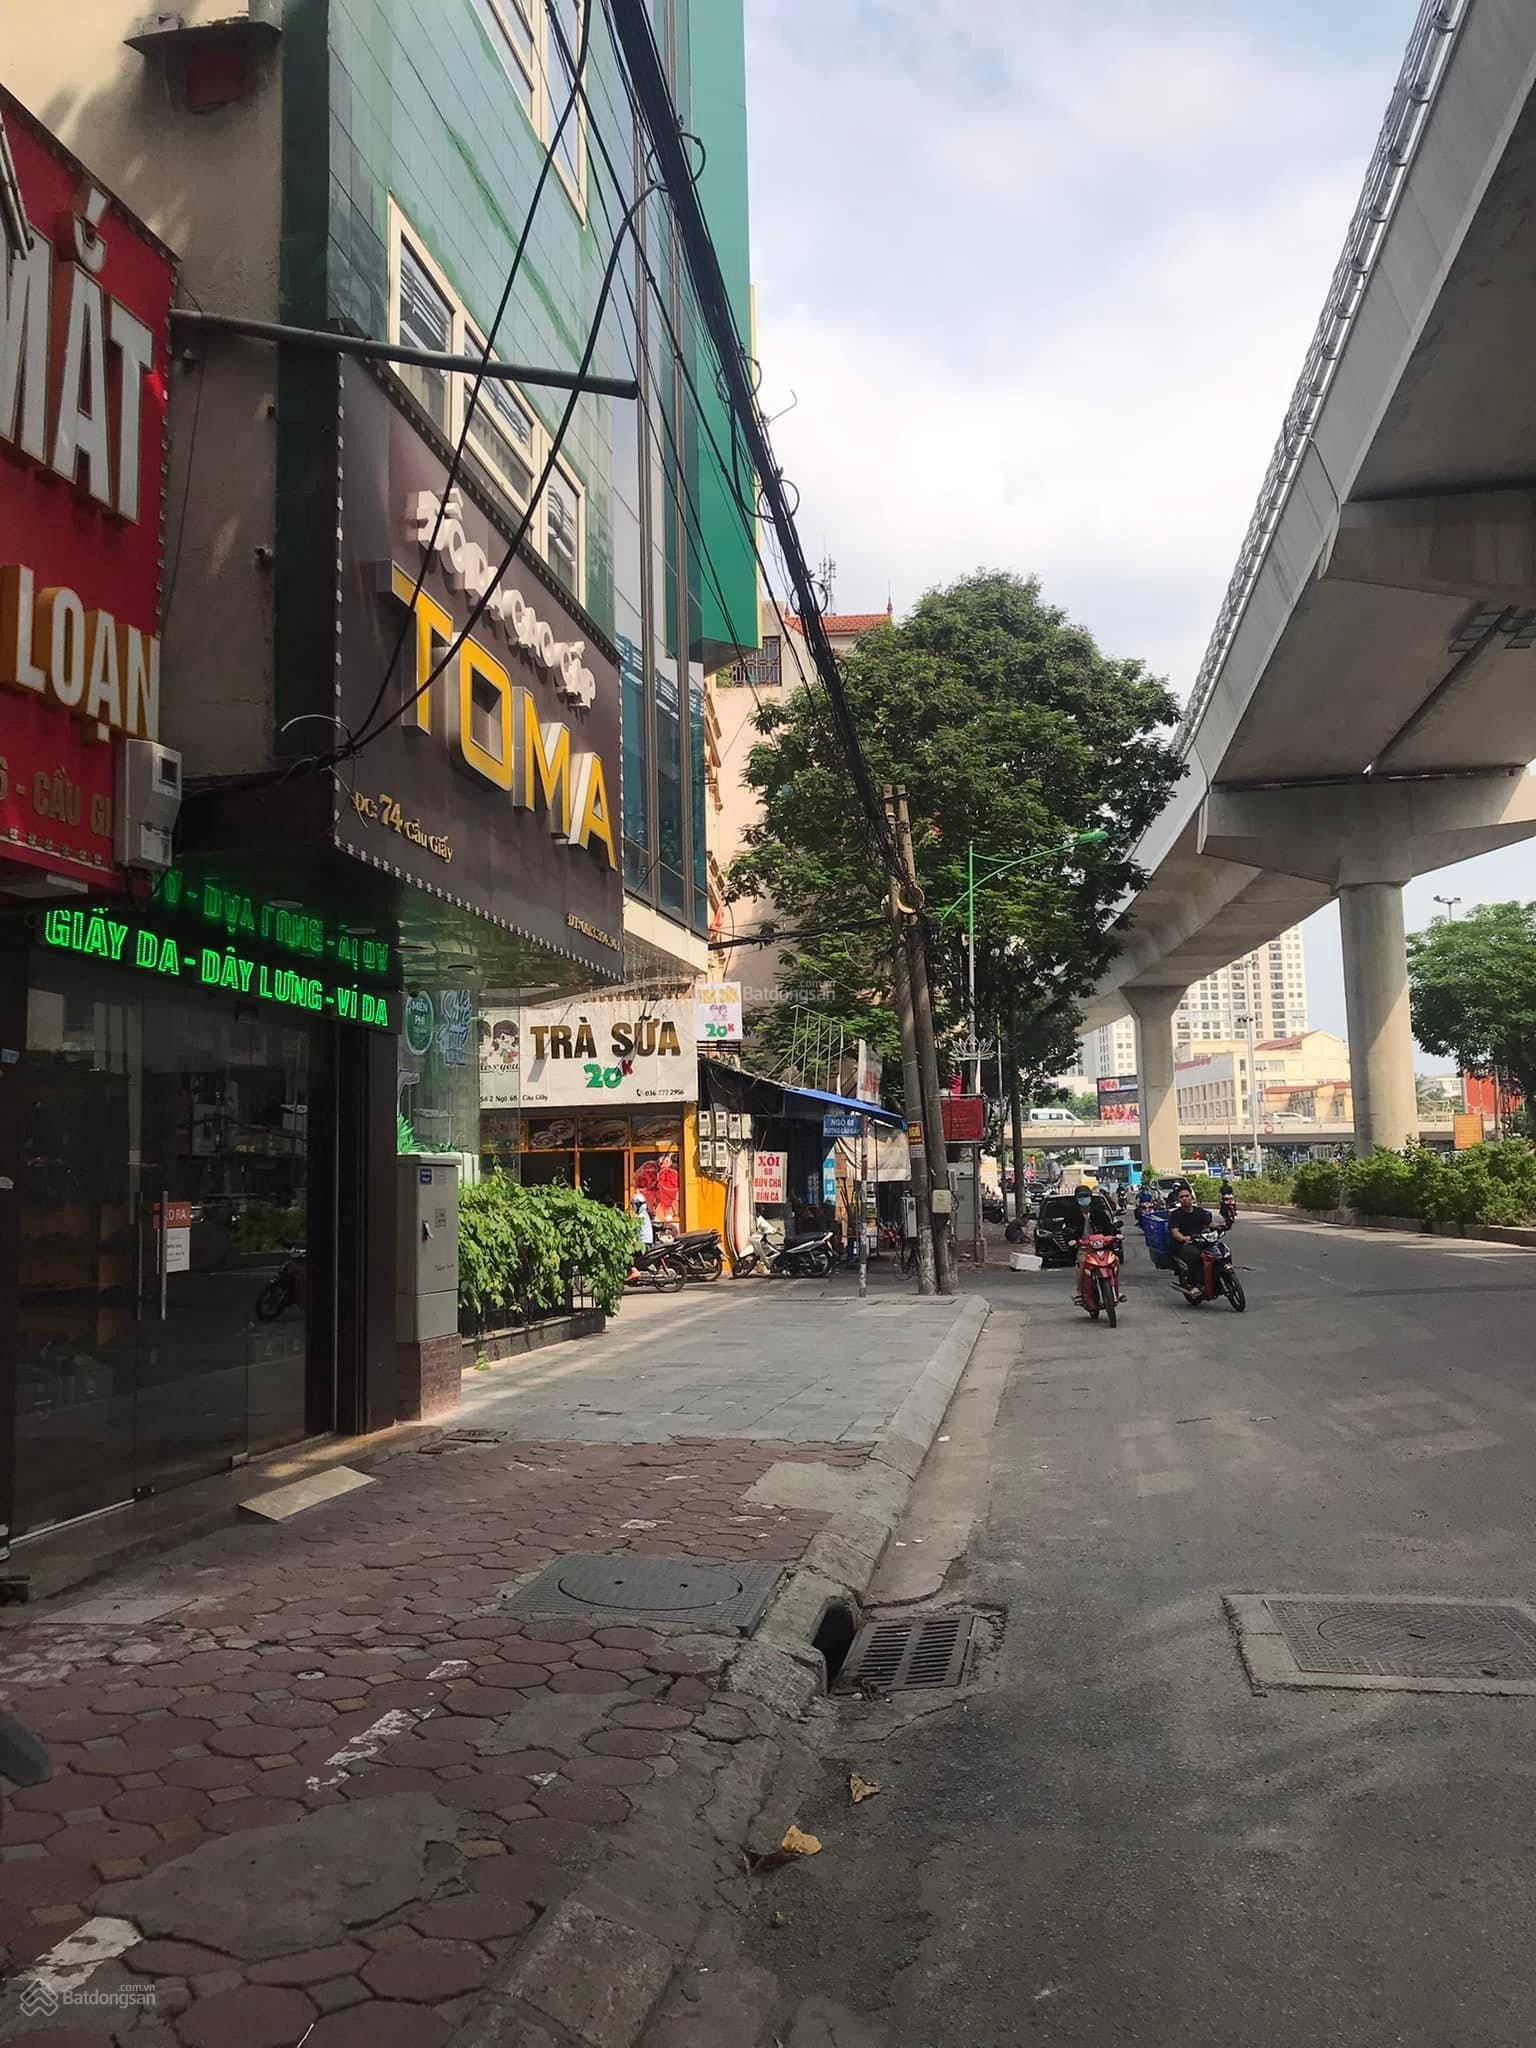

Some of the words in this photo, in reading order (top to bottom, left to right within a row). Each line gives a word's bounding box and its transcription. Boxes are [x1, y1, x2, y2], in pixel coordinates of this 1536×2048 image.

[15, 563, 160, 742] LOẠN
[386, 560, 618, 871] TOMA
[90, 794, 112, 836] GI
[379, 794, 403, 833] 74
[45, 907, 128, 960] GIẤY
[136, 930, 180, 975] DA
[202, 946, 254, 992] DÂY
[260, 965, 323, 1010] LƯNG
[530, 1016, 597, 1059] TRÀ
[611, 1015, 681, 1057] SỮA
[704, 1023, 735, 1037] 20K
[583, 1059, 633, 1089] 20K
[758, 1153, 780, 1167] XÔI
